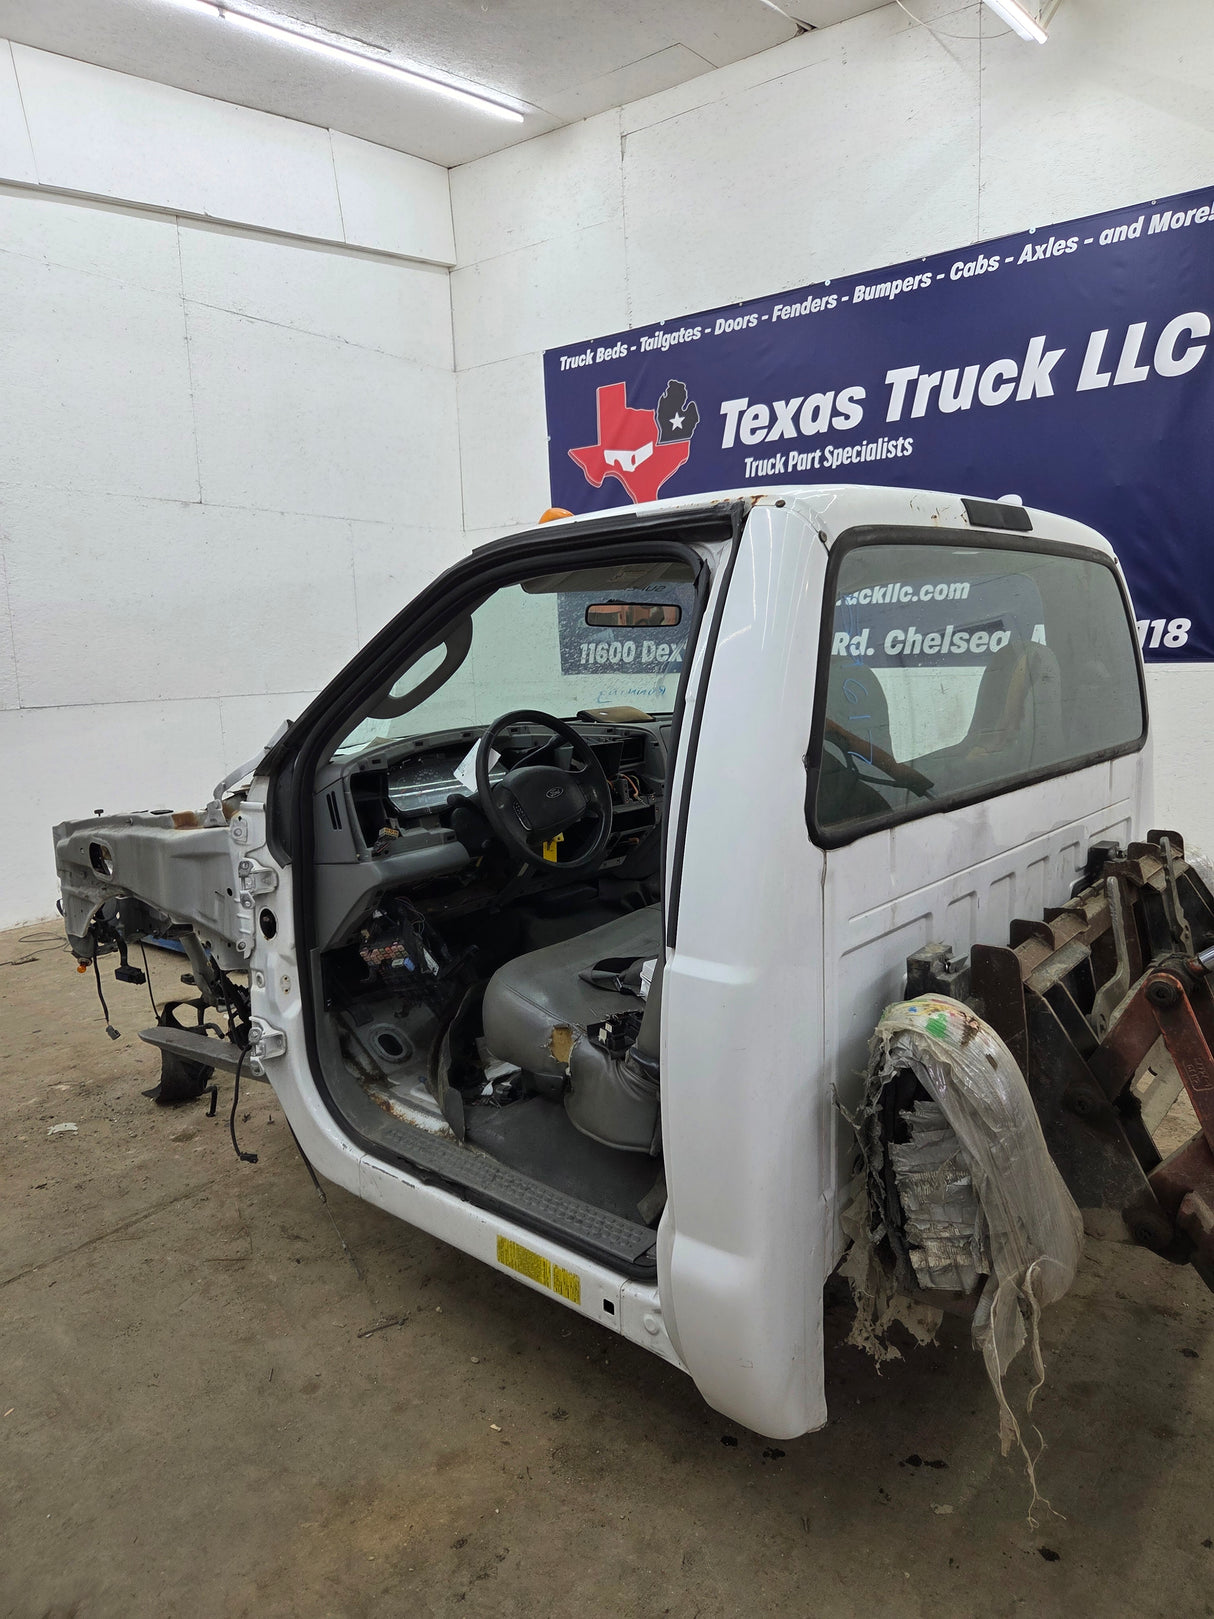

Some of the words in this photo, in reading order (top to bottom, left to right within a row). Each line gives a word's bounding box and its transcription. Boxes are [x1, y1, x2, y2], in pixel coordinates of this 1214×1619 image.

[560, 348, 594, 371] Truck
[595, 341, 628, 363] Beds
[639, 325, 702, 352] Tailgates
[714, 313, 759, 336] Doors
[771, 294, 837, 322] Fenders
[852, 272, 932, 304] Bumpers
[949, 254, 1001, 281] Cabs
[1017, 235, 1079, 265] Axles
[1099, 216, 1145, 246] and
[719, 385, 867, 449] Texas
[884, 334, 1067, 423] Truck
[1075, 311, 1211, 392] LLC
[744, 449, 785, 479] Truck
[787, 445, 822, 472] Part
[822, 435, 914, 469] Specialists
[580, 641, 635, 664] 11600
[641, 640, 687, 662] Dex
[831, 628, 875, 656] Rd.
[884, 625, 1011, 655] Chelsea
